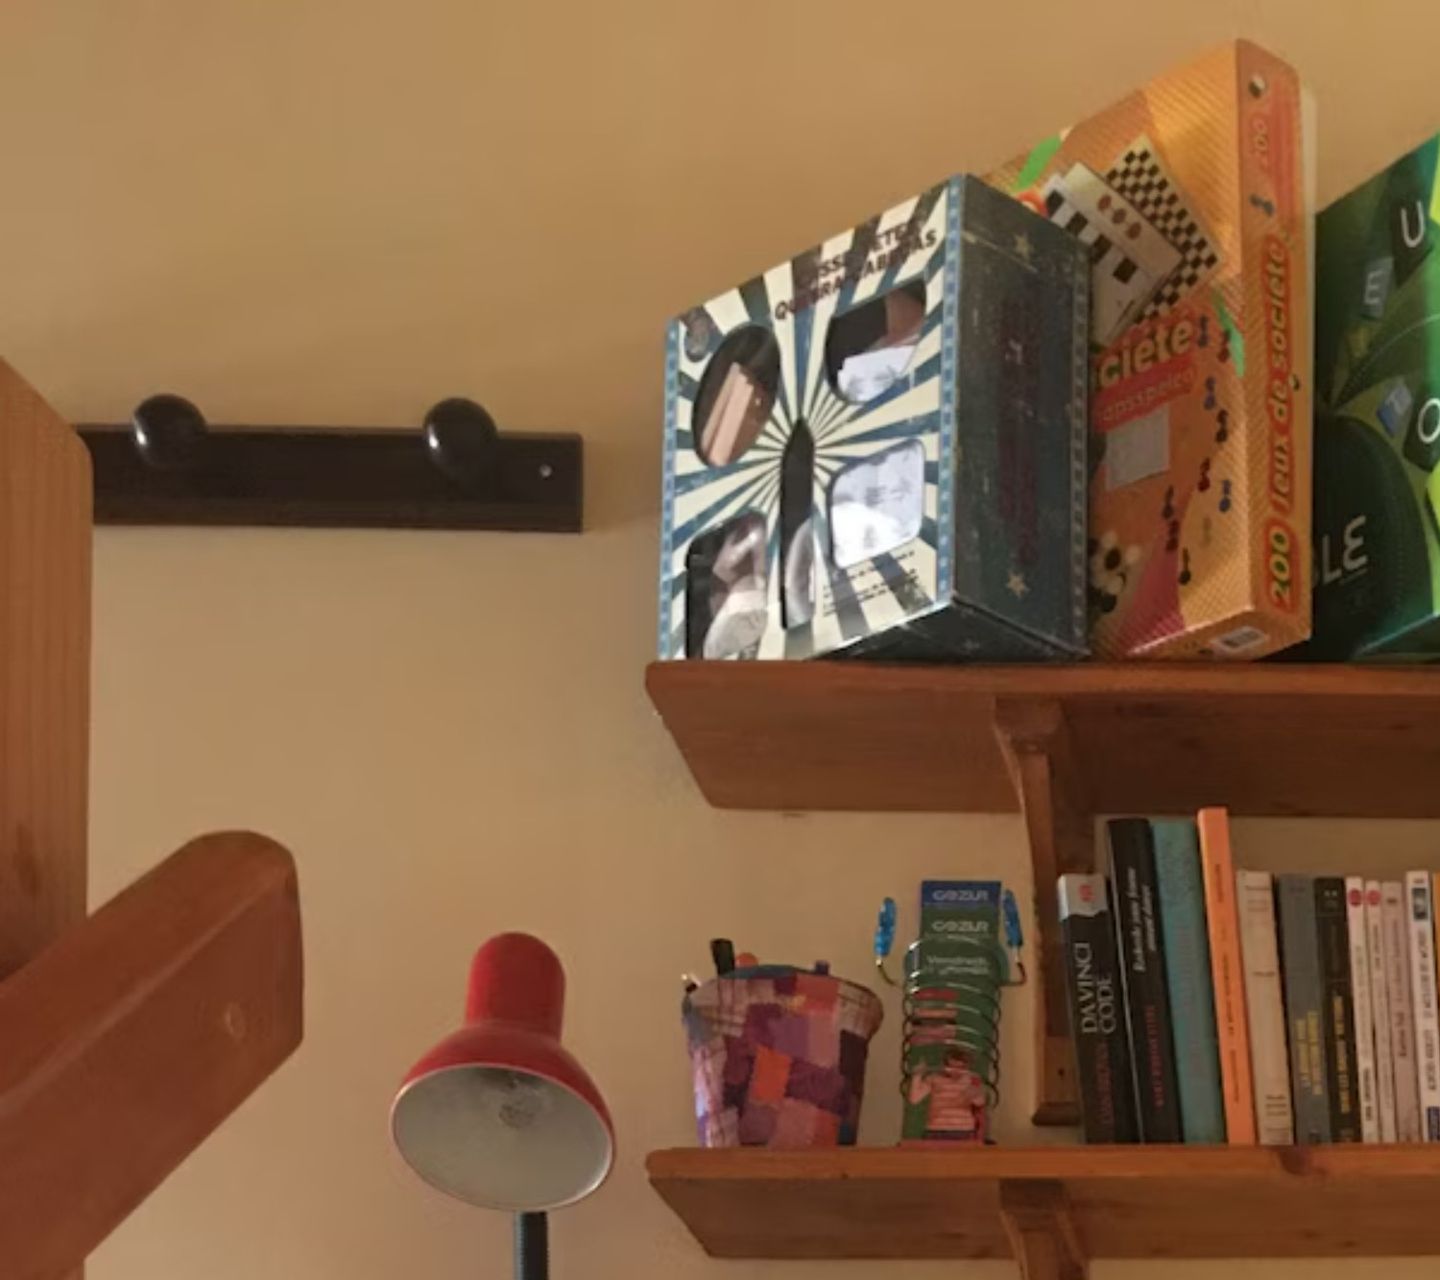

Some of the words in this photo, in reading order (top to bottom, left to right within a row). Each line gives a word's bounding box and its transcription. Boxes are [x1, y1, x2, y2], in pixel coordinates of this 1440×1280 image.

[1400, 200, 1426, 248] U
[1265, 376, 1290, 423] de
[1267, 527, 1293, 607] 200
[1072, 942, 1094, 1005] VINCI
[1078, 1005, 1097, 1034] DA
[1096, 975, 1117, 1034] CODE
